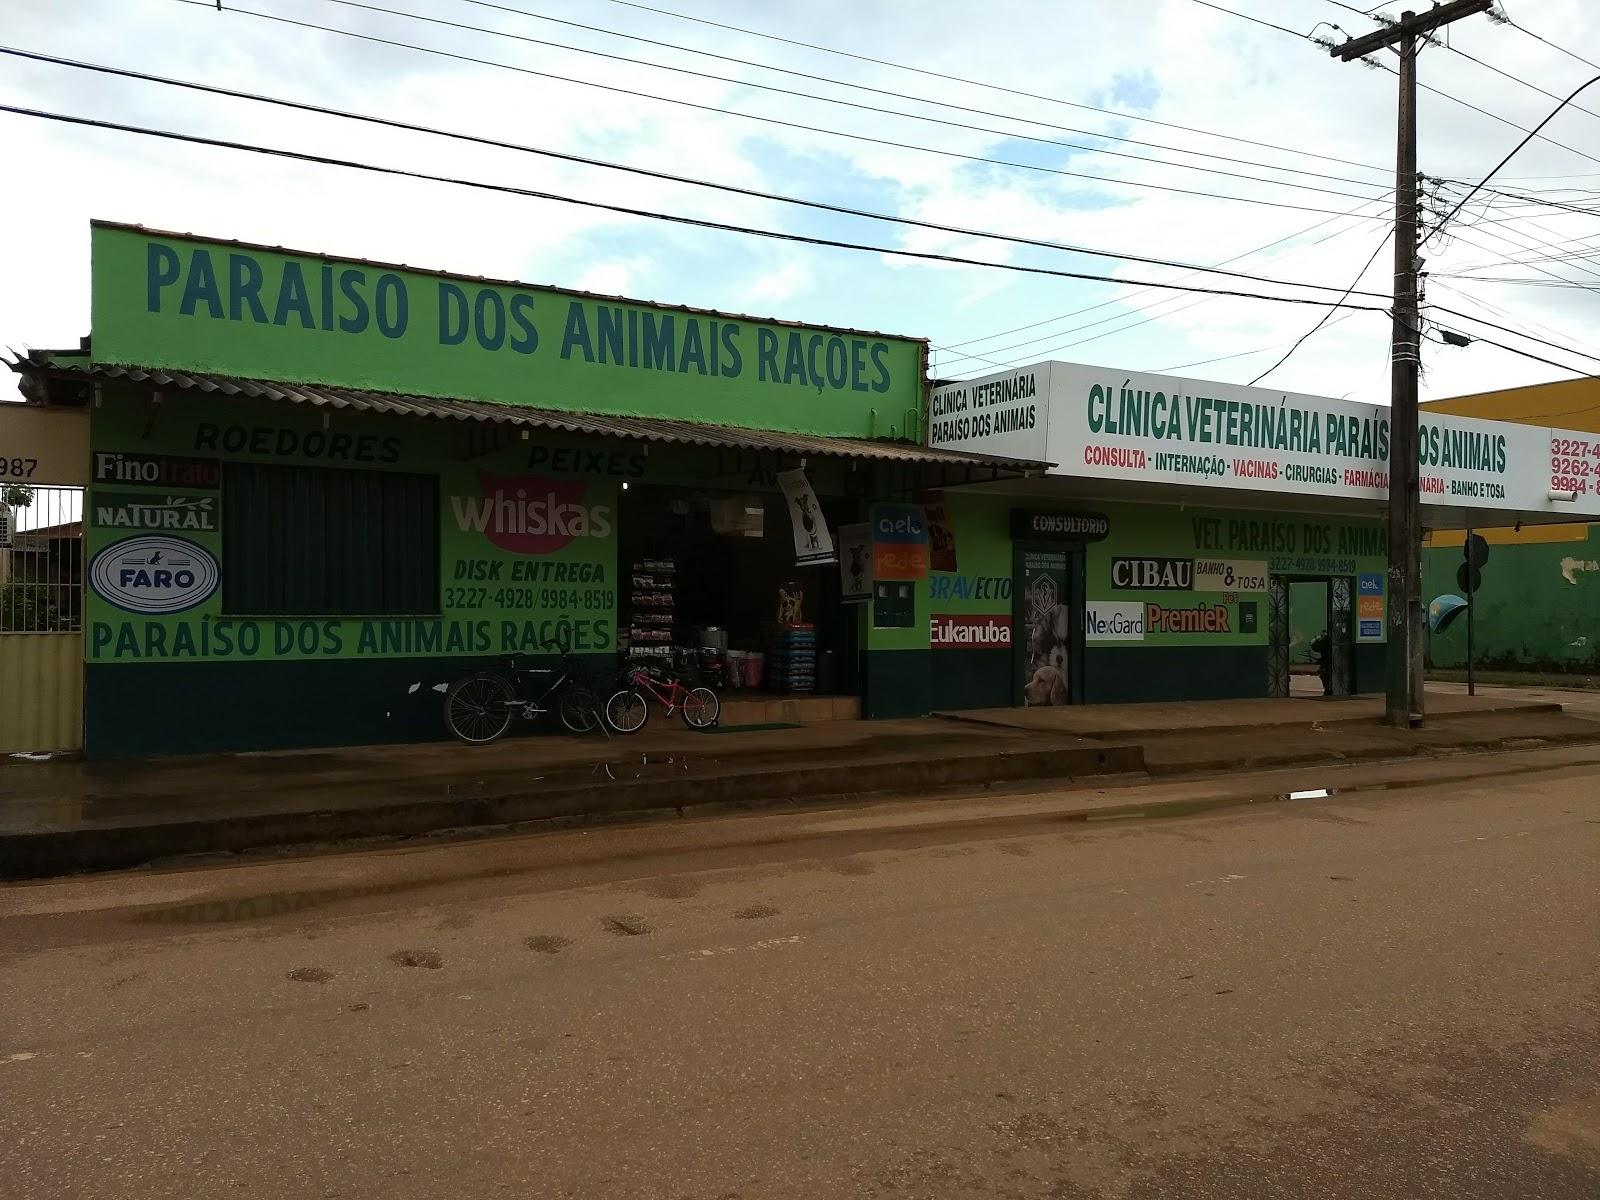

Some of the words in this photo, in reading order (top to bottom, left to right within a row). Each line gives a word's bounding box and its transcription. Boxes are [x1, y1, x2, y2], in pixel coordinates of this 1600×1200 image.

[147, 243, 409, 339] PARAÍSO
[438, 282, 539, 354] DOS
[560, 301, 742, 378] ANIMAIS
[757, 328, 891, 395] RAÇÕES
[933, 388, 967, 417] CLÍNICA
[972, 372, 1036, 409] VETERINÁRIA
[932, 414, 969, 444] PARAÍSO
[971, 413, 991, 438] DOS
[993, 405, 1036, 435] ANIMAIS
[1087, 379, 1182, 440] CLÍNICA
[1185, 395, 1321, 454] VETERINÁRIA
[1325, 409, 1390, 461] PARAÍS
[1418, 424, 1440, 467] OS
[1441, 429, 1506, 474] ANIMAIS
[194, 423, 401, 463] ROEDORES
[528, 446, 648, 478] PEIXES
[1084, 445, 1146, 470] CONSULTA
[1155, 452, 1225, 480] INTERNAÇÃO
[1232, 459, 1278, 480] VACINAS
[1285, 464, 1338, 485] CIRURGIAS
[1344, 467, 1389, 489] FARMÁCIA
[1451, 481, 1478, 498] BANHO
[1479, 483, 1485, 497] E
[1486, 483, 1505, 499] TOSA
[97, 503, 214, 530] NATURAL
[1229, 516, 1296, 553] PARAÍSO
[1303, 523, 1332, 554] DOS
[1338, 526, 1387, 557] ANIMA
[120, 569, 195, 588] FARO
[454, 559, 504, 580] DISK
[511, 561, 605, 582] ENTREGA
[1113, 560, 1191, 587] CIBAU
[1197, 562, 1224, 575] BANHO
[1224, 566, 1235, 586] &
[1238, 576, 1265, 589] TOSA
[92, 613, 261, 658] PARAÍSO
[274, 621, 343, 655] DOS
[357, 620, 491, 654] ANIMAIS
[929, 620, 1011, 643] Eukanuba
[1087, 611, 1143, 634] NexGard
